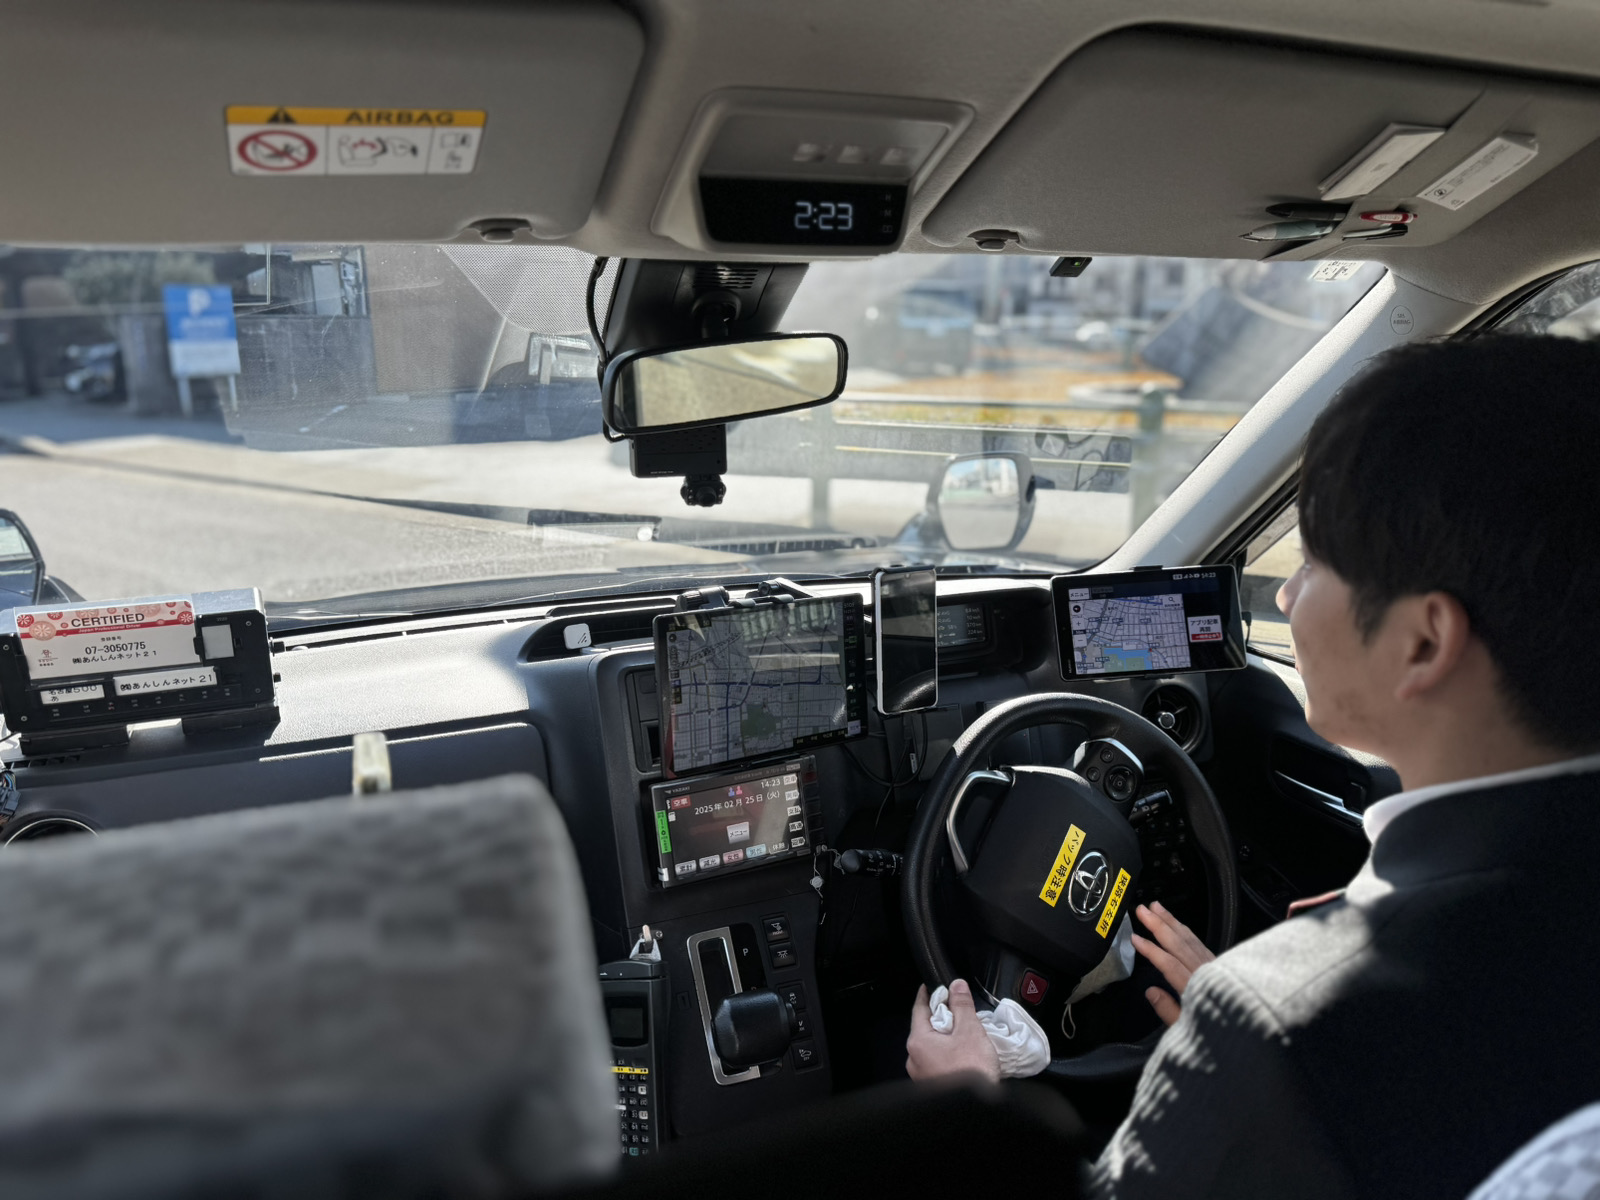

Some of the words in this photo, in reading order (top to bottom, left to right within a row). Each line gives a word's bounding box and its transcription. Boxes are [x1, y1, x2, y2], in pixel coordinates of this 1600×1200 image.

[345, 110, 455, 125] AIRBAG
[794, 201, 853, 231] 2:23
[70, 613, 146, 628] CERTIFIED
[94, 624, 126, 632] Professional
[84, 641, 146, 655] 07-3050775
[761, 778, 781, 789] 14:23
[729, 829, 748, 838] メニュー
[1045, 830, 1080, 901] バック時注意
[742, 947, 749, 957] P
